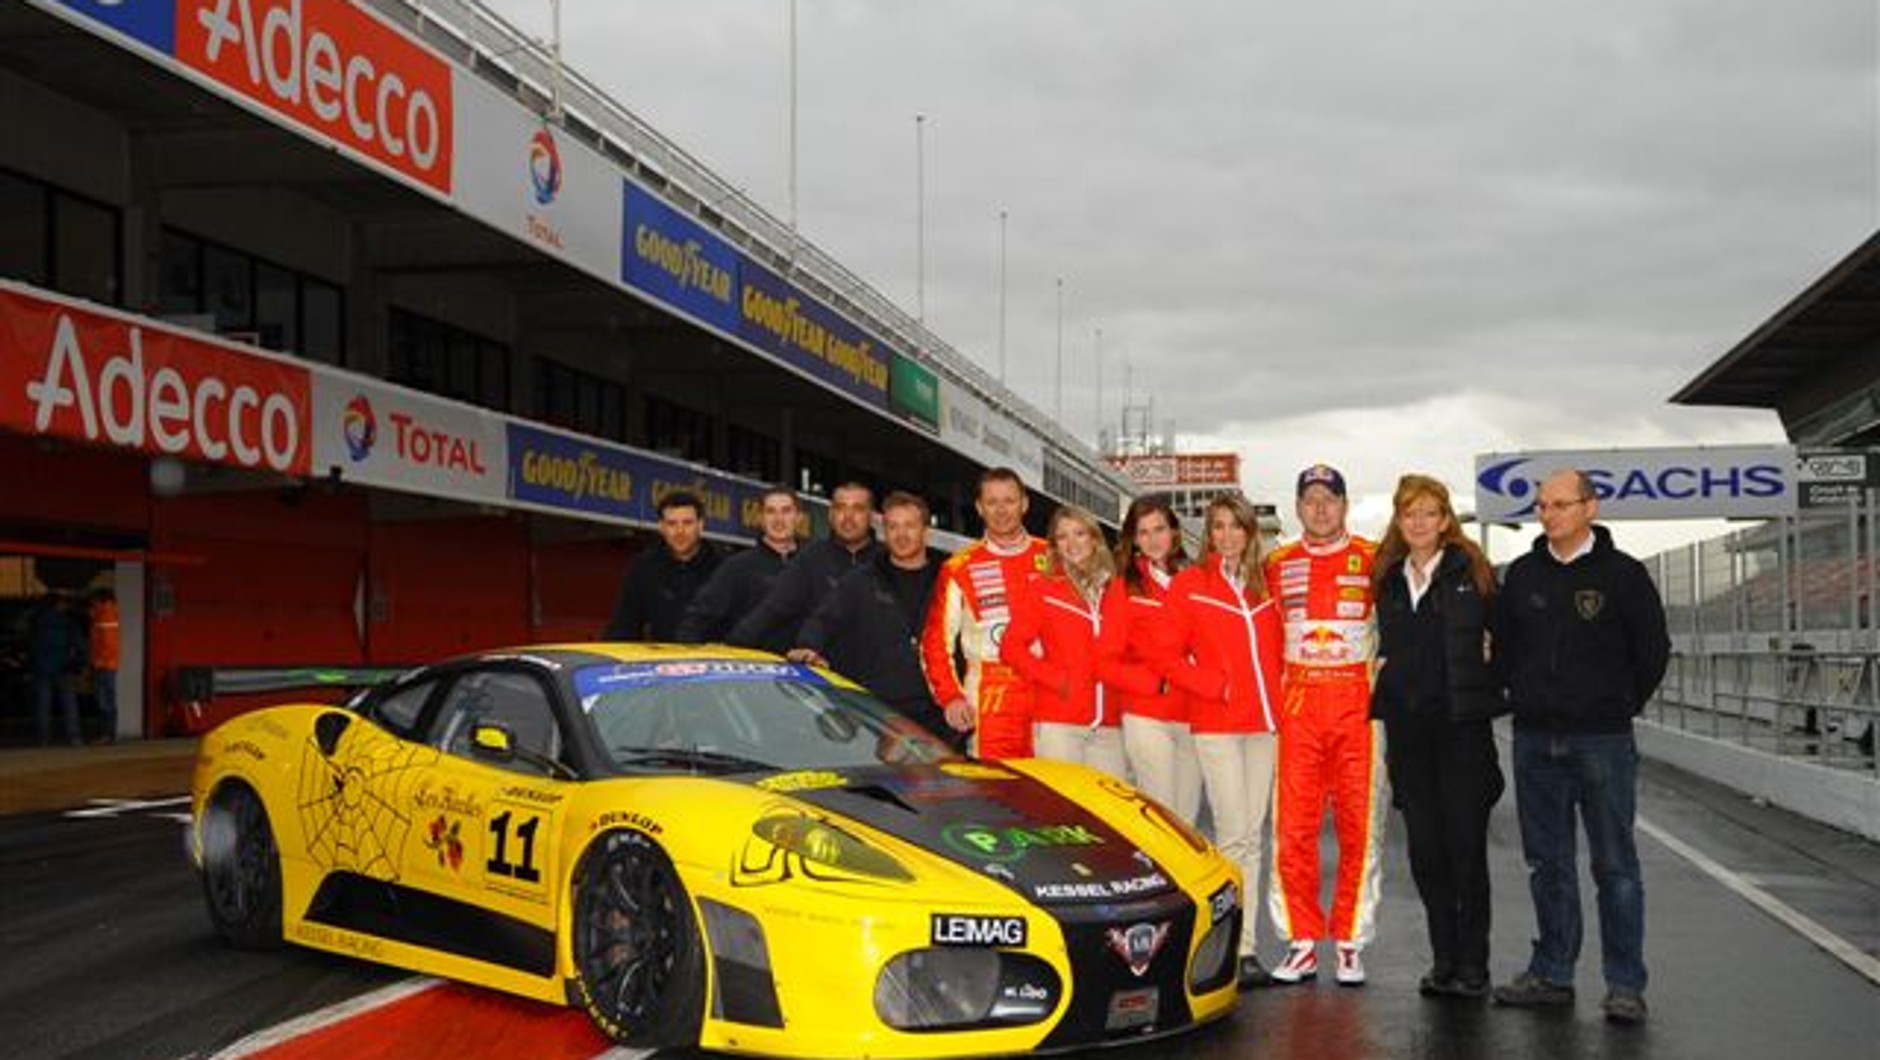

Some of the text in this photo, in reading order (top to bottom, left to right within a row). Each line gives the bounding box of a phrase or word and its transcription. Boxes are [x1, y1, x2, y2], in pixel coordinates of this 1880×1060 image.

[198, 0, 439, 170] Adecco
[635, 223, 731, 304] GOODYEAR
[743, 284, 889, 391] GOODYEAR GOODYEAR
[26, 314, 298, 471] Adecco
[389, 413, 486, 475] TOTAL
[522, 450, 631, 502] GOODYEAR
[1588, 464, 1786, 500] SACHS
[487, 810, 540, 883] 11
[590, 811, 664, 835] DUNLOP
[1034, 882, 1112, 899] KESSEL
